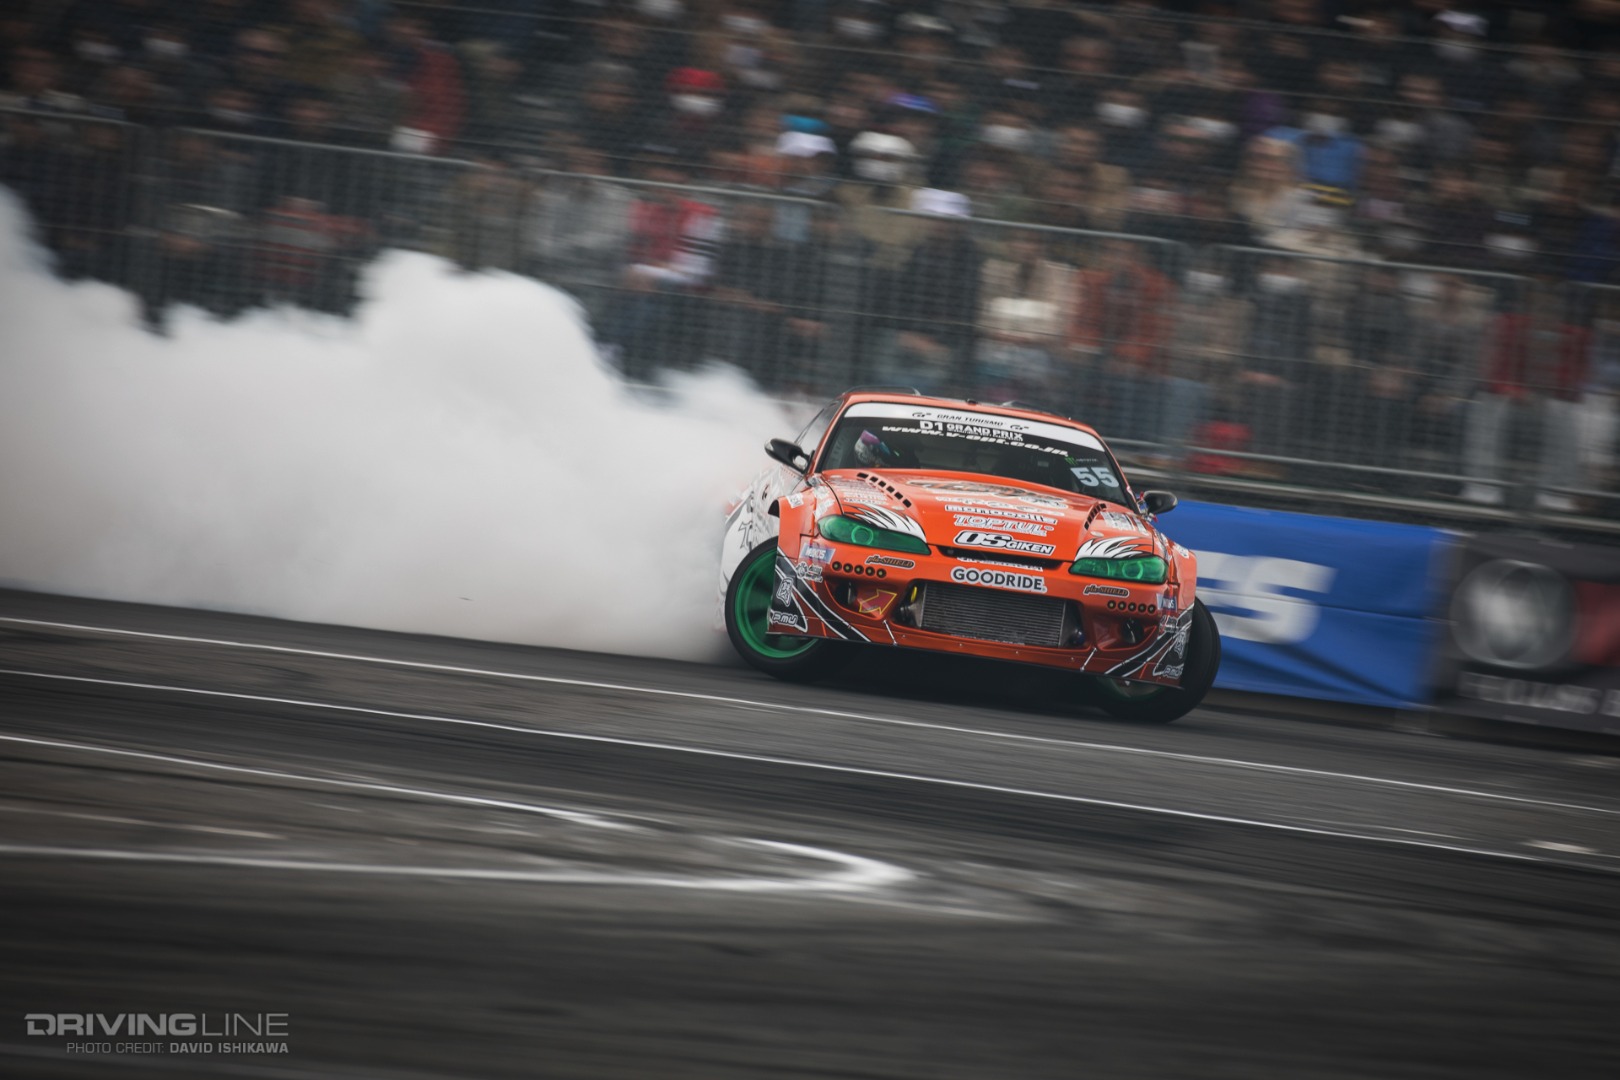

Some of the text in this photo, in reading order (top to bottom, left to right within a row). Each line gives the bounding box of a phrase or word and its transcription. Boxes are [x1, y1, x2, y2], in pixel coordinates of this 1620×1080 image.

[919, 420, 943, 431] D1
[947, 423, 990, 435] GRAND
[992, 429, 1023, 440] PRIX
[937, 413, 962, 422] GRAN
[965, 416, 1004, 427] TURISMO
[1070, 467, 1120, 488] 55
[954, 513, 1043, 531] TOPTUL
[957, 531, 1053, 555] OS GIKEN
[952, 568, 1043, 590] GOODRIDE
